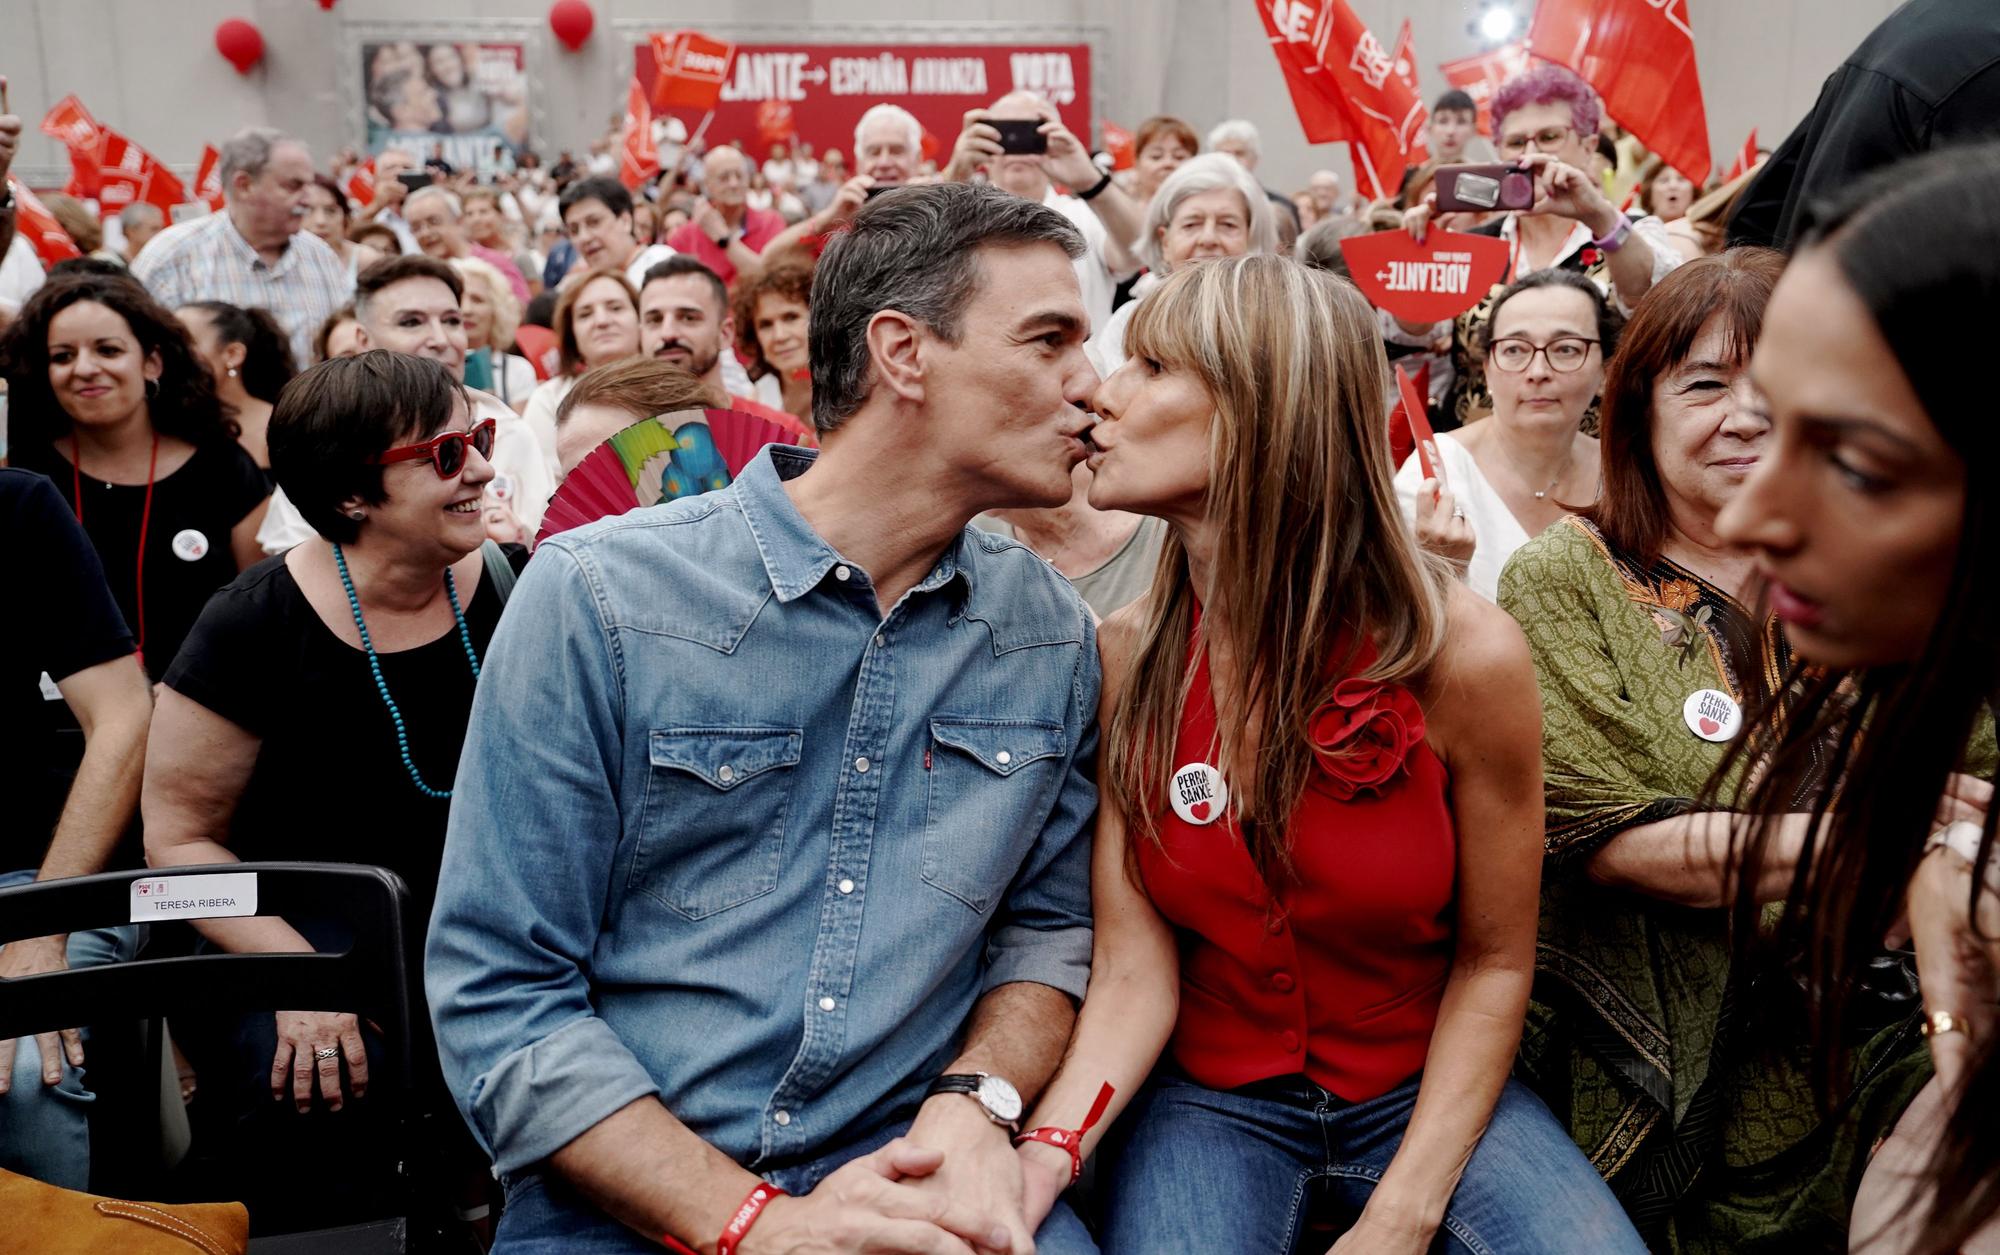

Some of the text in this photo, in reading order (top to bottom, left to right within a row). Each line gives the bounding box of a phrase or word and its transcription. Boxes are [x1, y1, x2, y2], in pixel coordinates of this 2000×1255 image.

[830, 52, 908, 94] ESPAÑA
[911, 57, 988, 95] AVANZA
[1385, 261, 1470, 293] ADELANTE
[1698, 702, 1730, 724] SANXE
[1177, 770, 1208, 790] PERRA
[1180, 782, 1213, 805] SANXE
[155, 898, 236, 909] TERESA RIBERA
